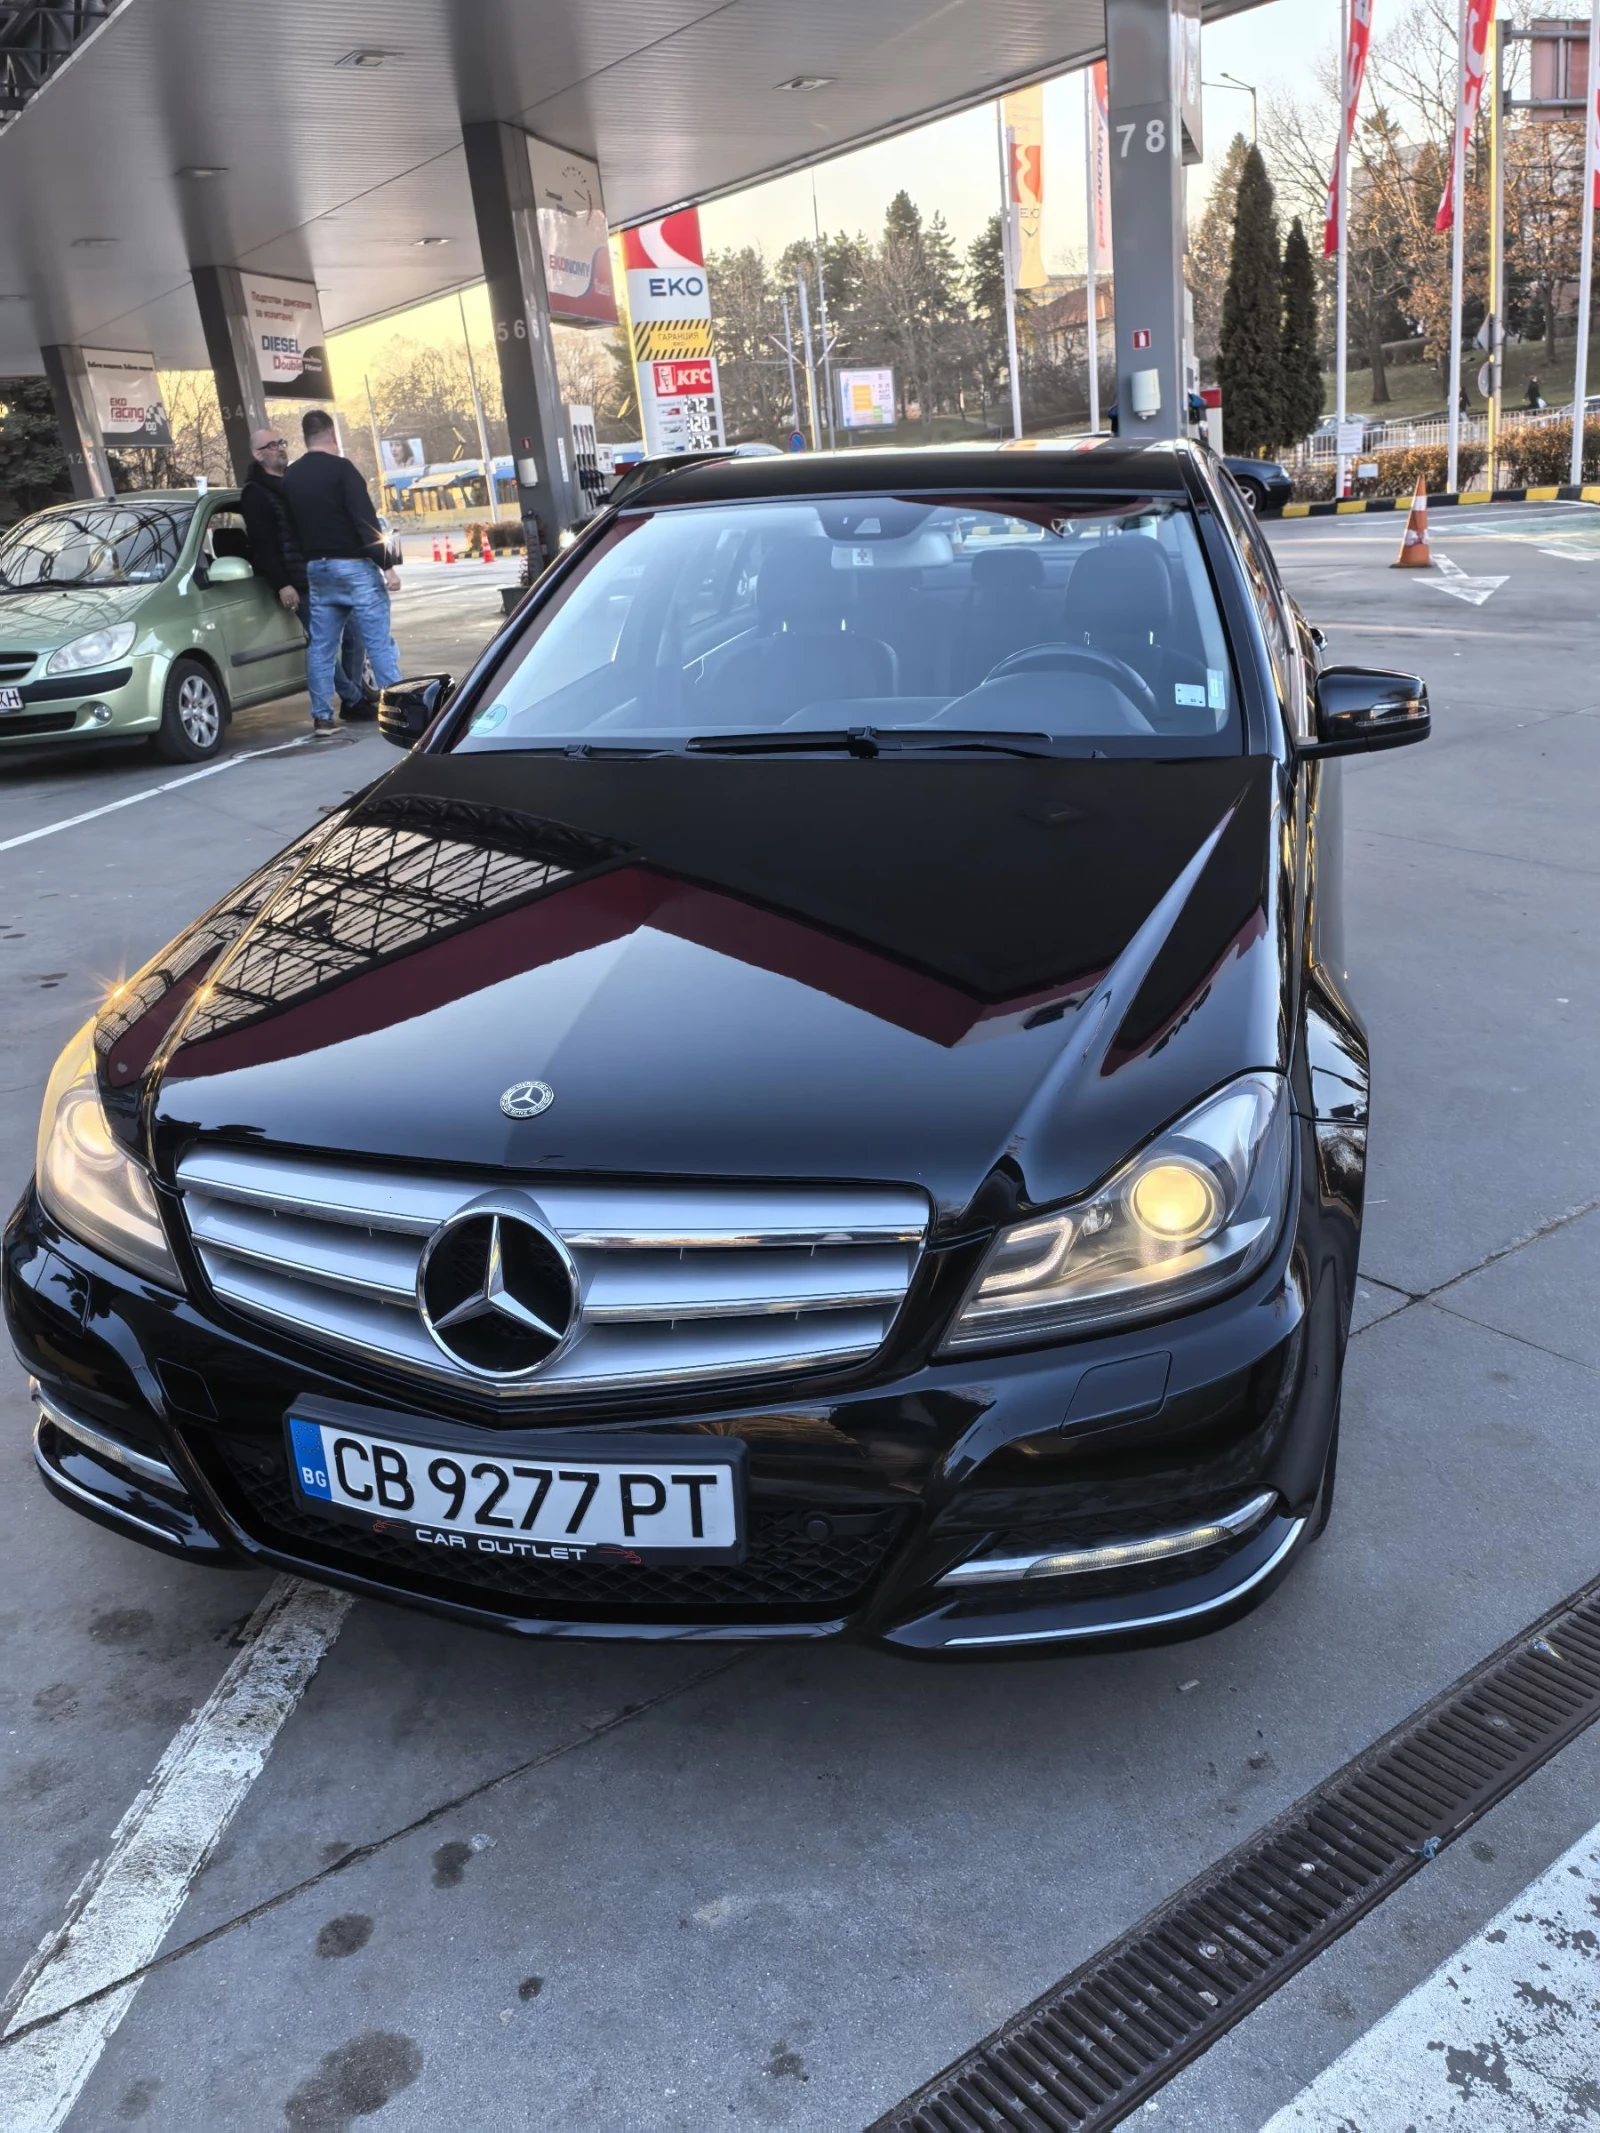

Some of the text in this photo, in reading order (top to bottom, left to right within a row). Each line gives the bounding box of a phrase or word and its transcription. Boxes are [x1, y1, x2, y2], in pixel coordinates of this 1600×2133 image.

[1116, 119, 1166, 158] 7 8
[549, 254, 590, 278] EKONOMY
[649, 276, 703, 297] EKO
[496, 321, 509, 342] 5
[513, 319, 526, 339] 6
[658, 331, 699, 341] ГАРАНЦИЯ
[261, 335, 302, 354] DIESEL
[272, 355, 304, 372] Double
[677, 367, 712, 386] KFC
[110, 398, 127, 407] EKO
[222, 406, 231, 420] 3
[235, 404, 244, 418] 4
[111, 407, 145, 422] racing
[145, 422, 157, 432] 100
[302, 1466, 327, 1488] BG
[333, 1437, 718, 1538] CB 9277 PT
[415, 1529, 587, 1561] CAR OUTLET
